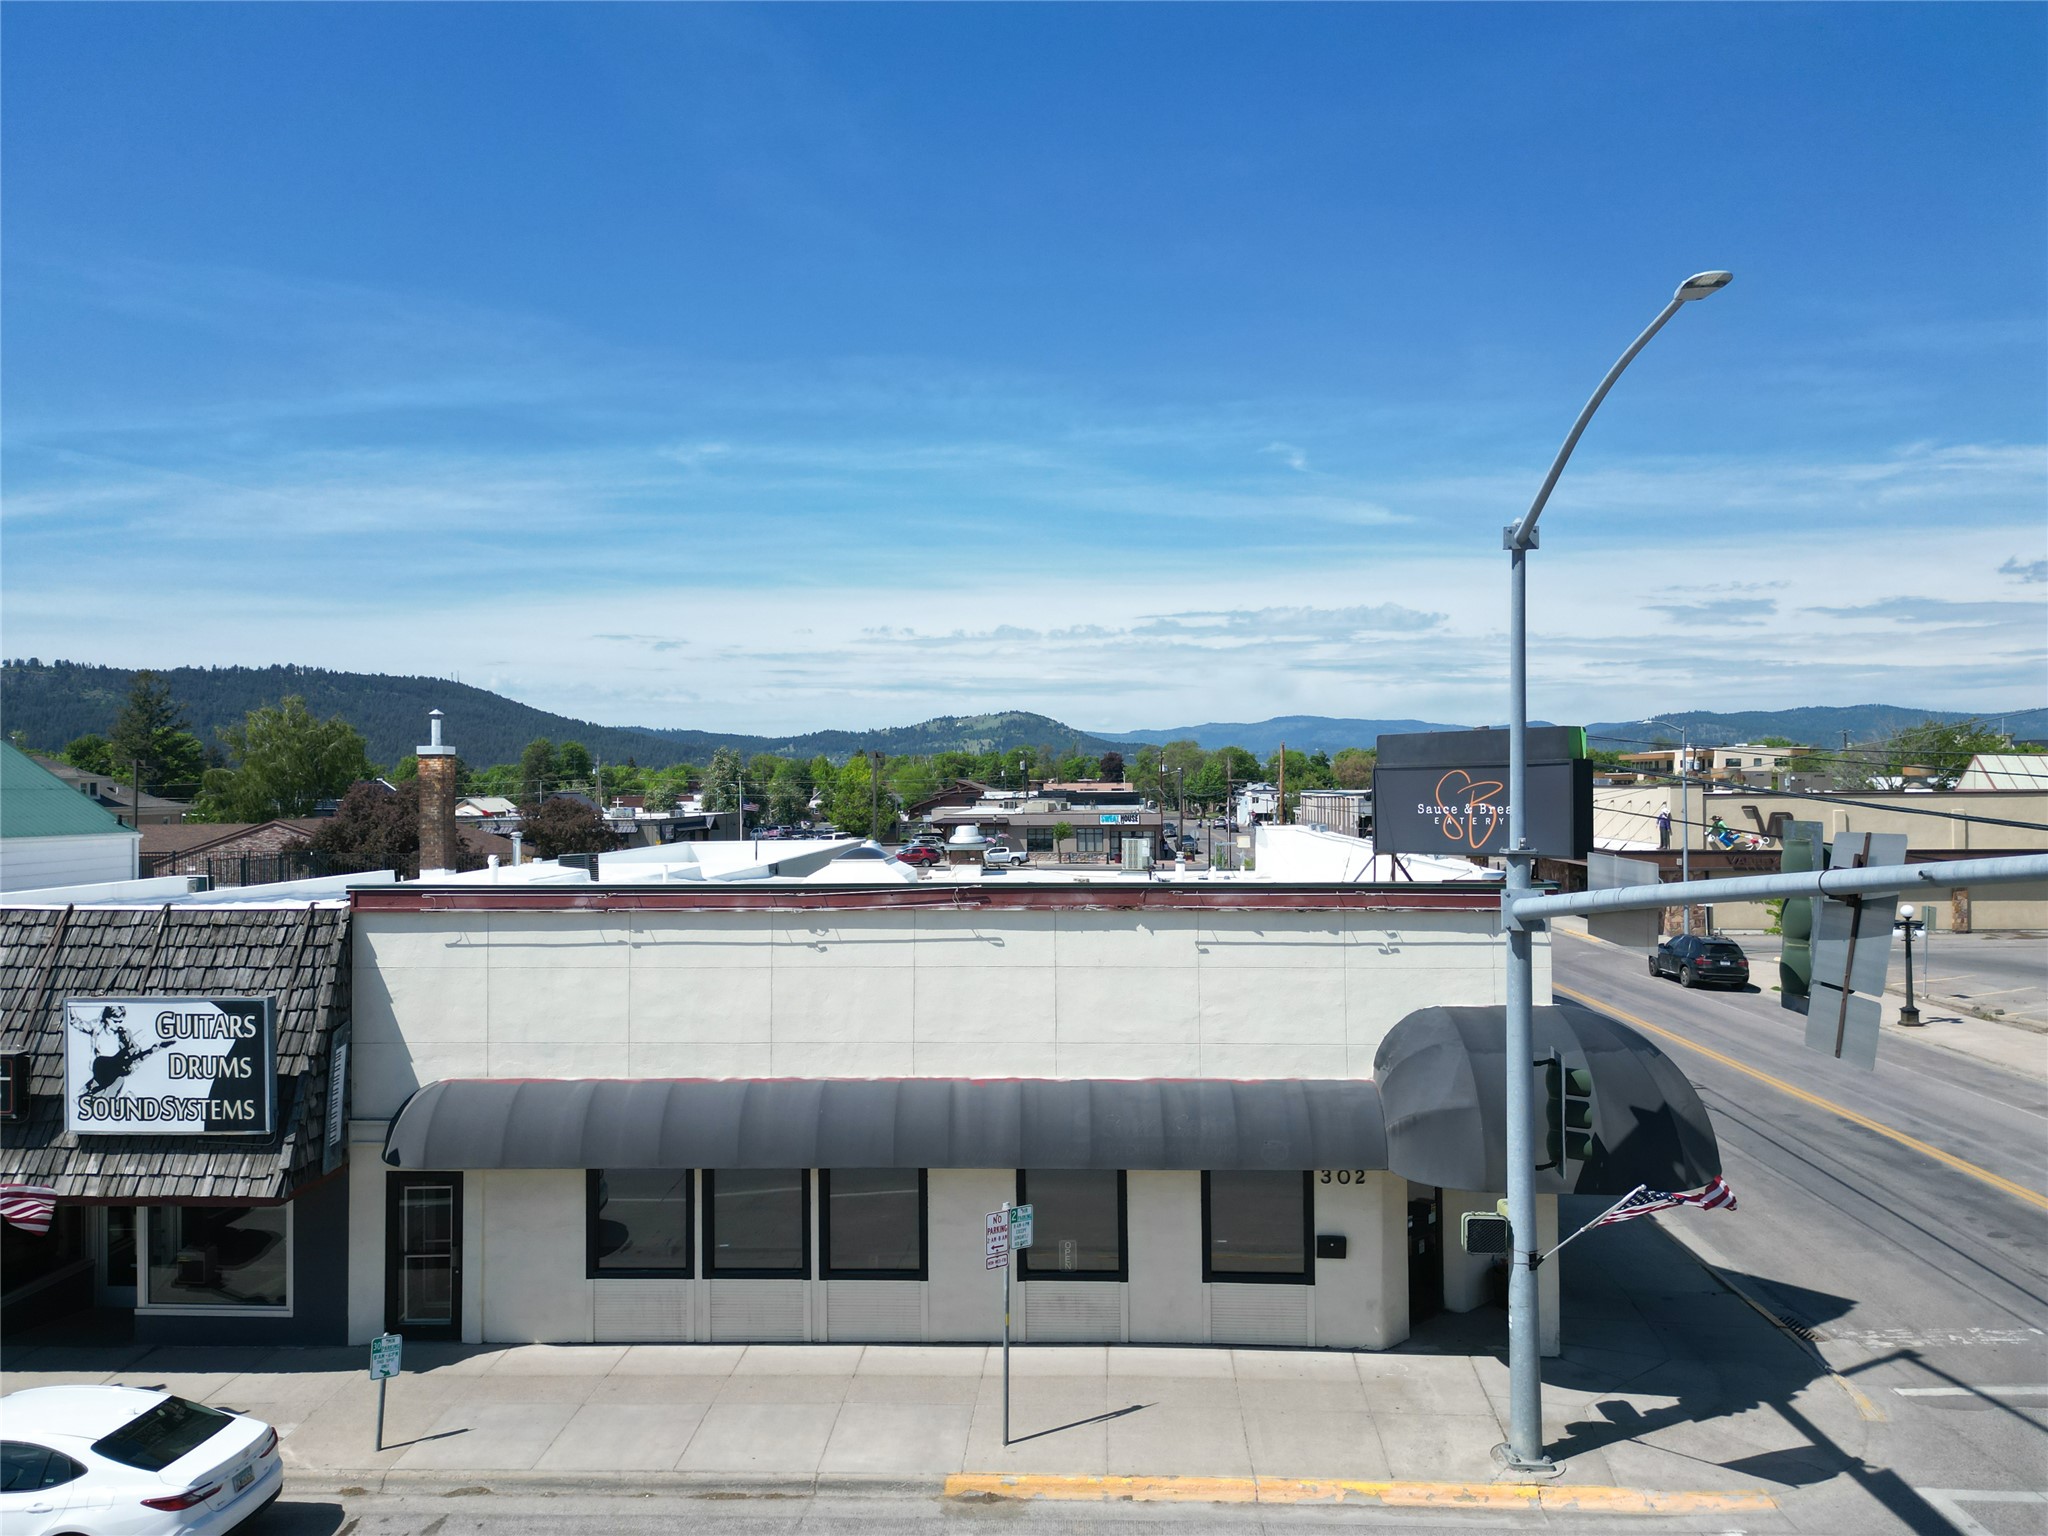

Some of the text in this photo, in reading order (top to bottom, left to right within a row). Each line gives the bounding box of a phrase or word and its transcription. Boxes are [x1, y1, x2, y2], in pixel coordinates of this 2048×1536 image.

[1417, 803, 1511, 815] Sauce & Brea
[1120, 814, 1139, 824] HOUSE
[1434, 817, 1504, 825] EATERY
[155, 1011, 257, 1039] GUITARS
[168, 1053, 252, 1079] DRUMS
[1320, 1169, 1365, 1184] 302
[993, 1216, 1002, 1224] NO
[1012, 1210, 1017, 1221] 2
[987, 1225, 1007, 1235] PARKING
[373, 1342, 381, 1351] 30
